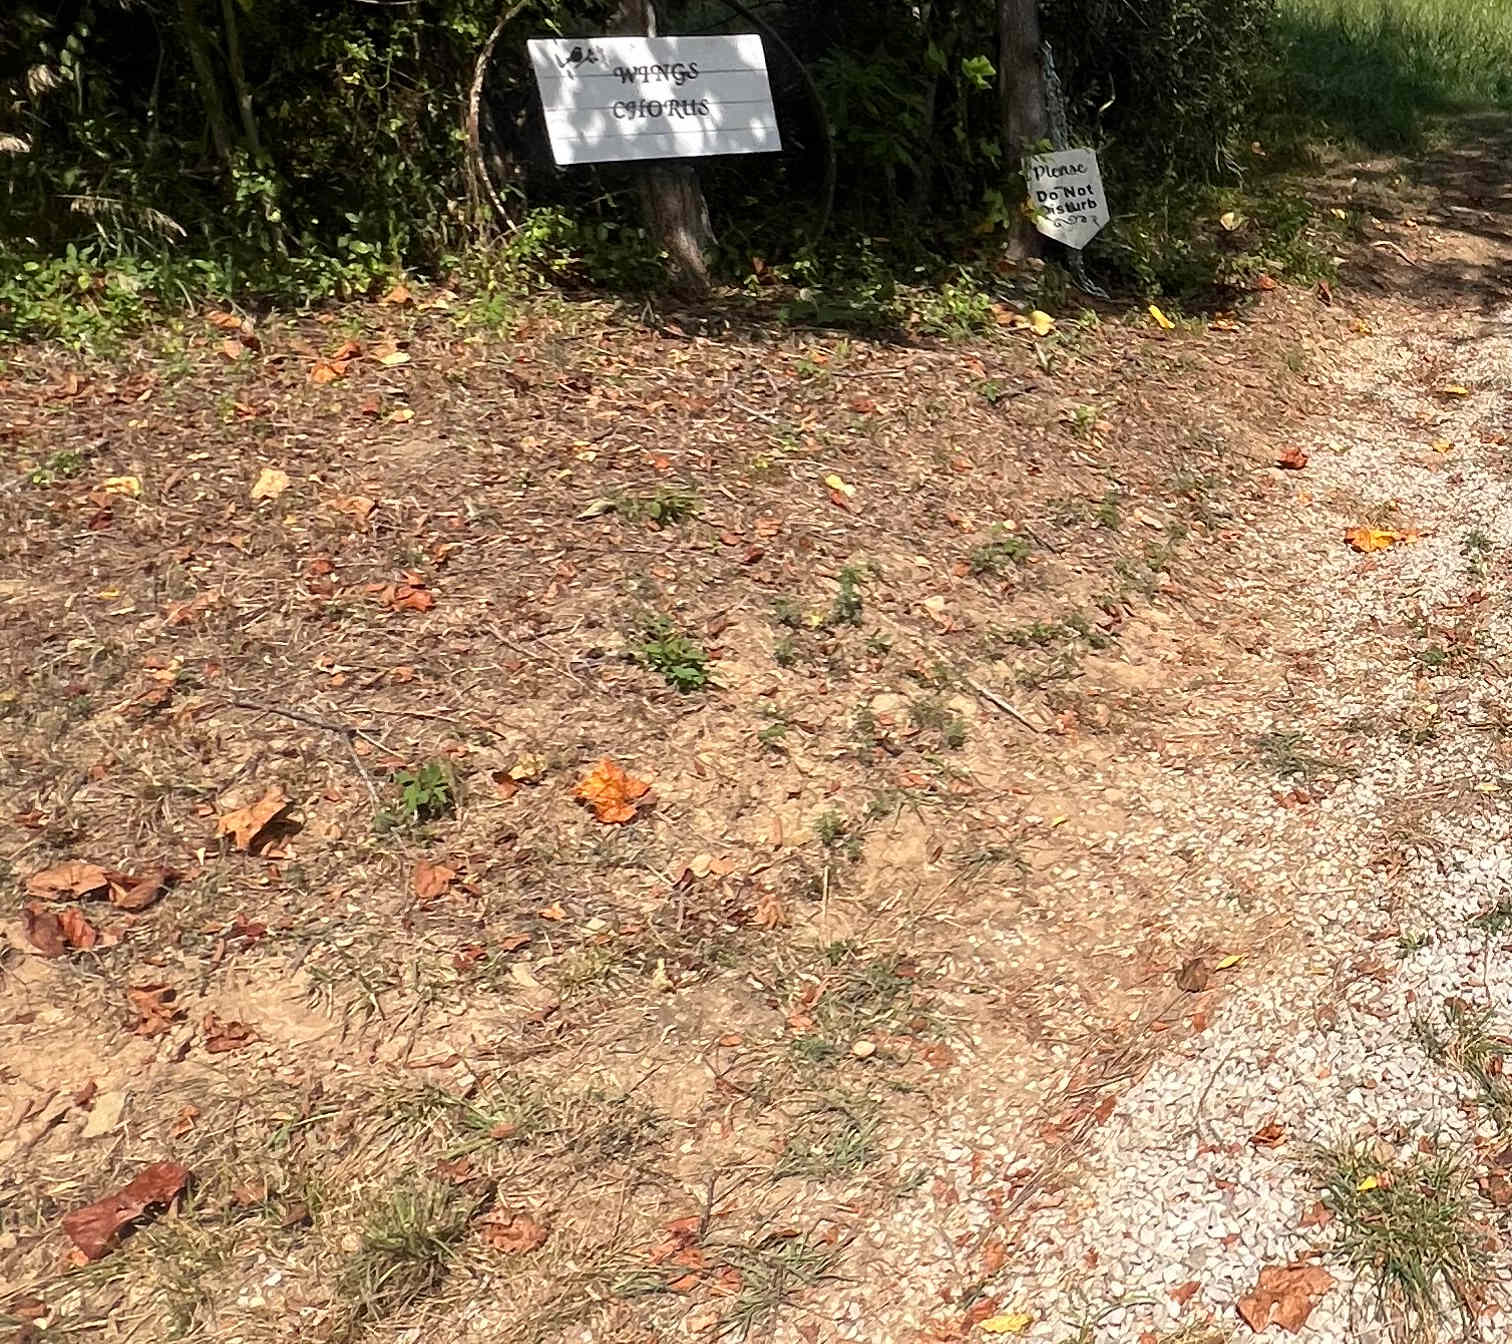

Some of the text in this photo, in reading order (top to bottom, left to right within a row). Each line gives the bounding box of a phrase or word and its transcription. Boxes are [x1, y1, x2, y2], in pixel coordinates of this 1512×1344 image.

[613, 62, 698, 86] WINGS
[613, 98, 710, 120] CHORUS
[1033, 163, 1088, 181] Please
[1037, 184, 1094, 202] Do Not
